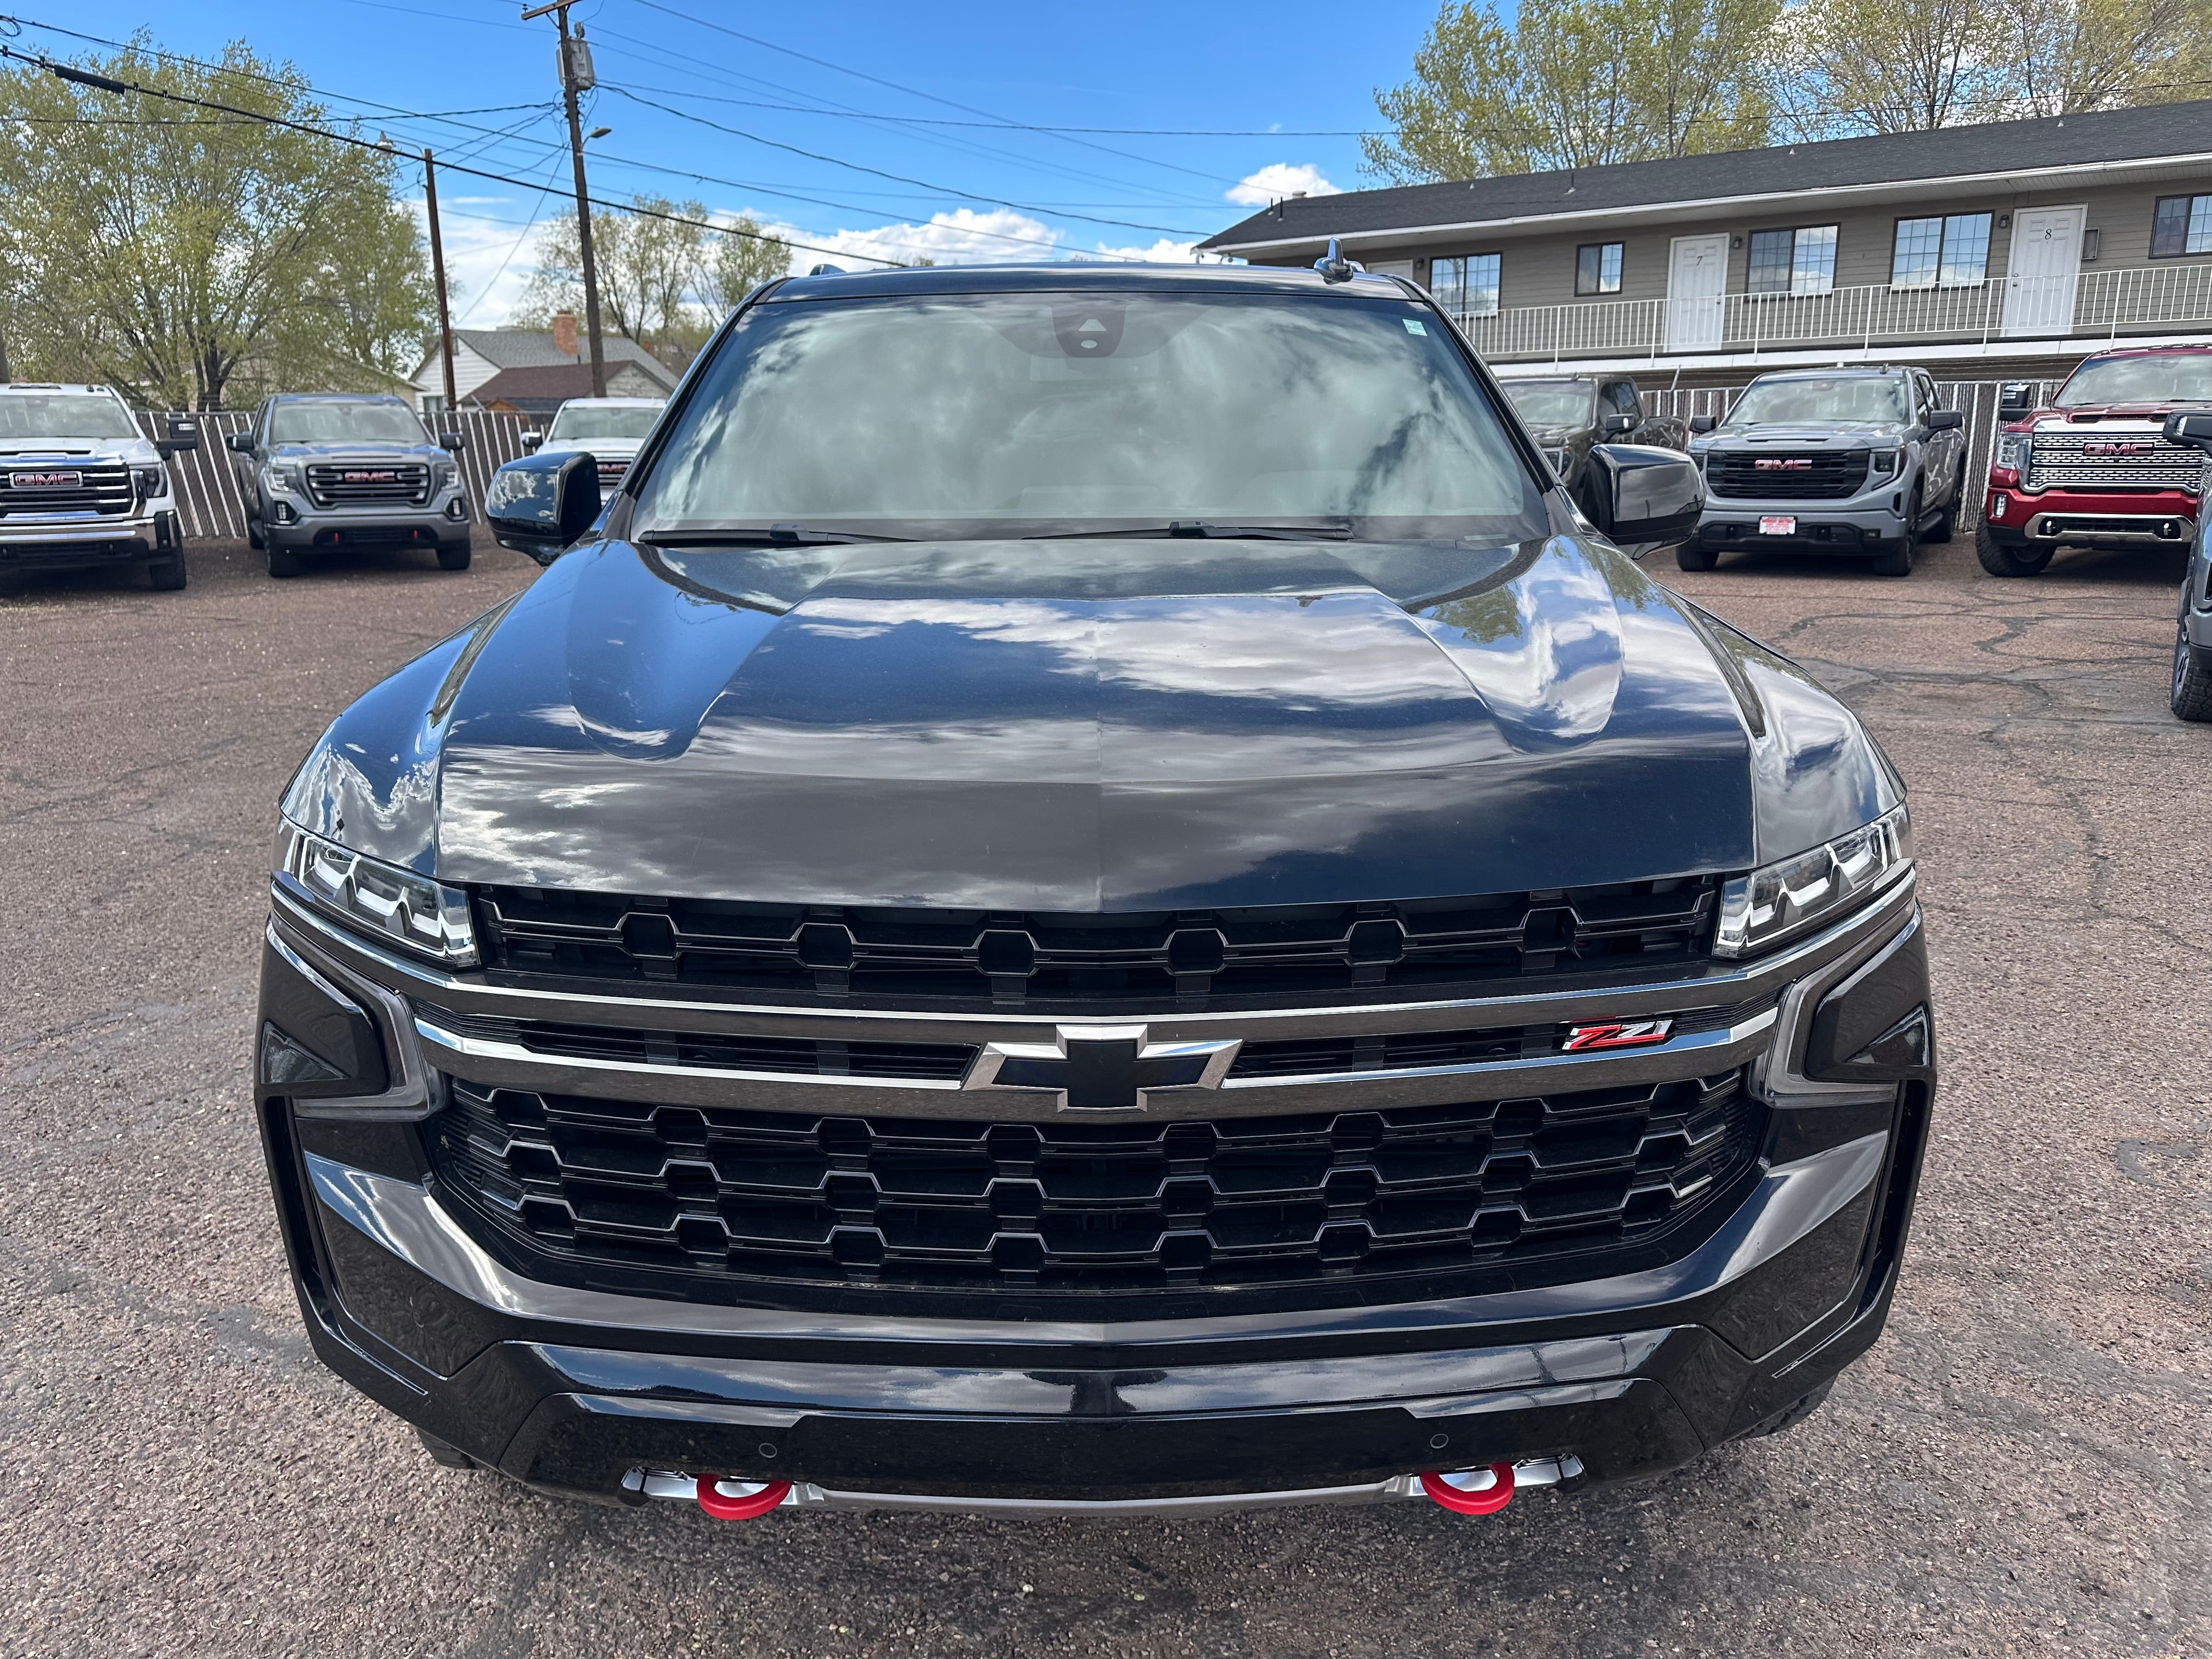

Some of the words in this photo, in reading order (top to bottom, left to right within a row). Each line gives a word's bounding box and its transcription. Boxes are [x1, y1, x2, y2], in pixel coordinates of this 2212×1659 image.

[2045, 228, 2052, 240] 8
[1696, 256, 1703, 266] 7
[2085, 443, 2153, 455] GMC
[1755, 460, 1812, 470] GMC
[15, 474, 78, 486] GMC
[345, 472, 395, 482] GMC
[1562, 1019, 1673, 1050] Z71
